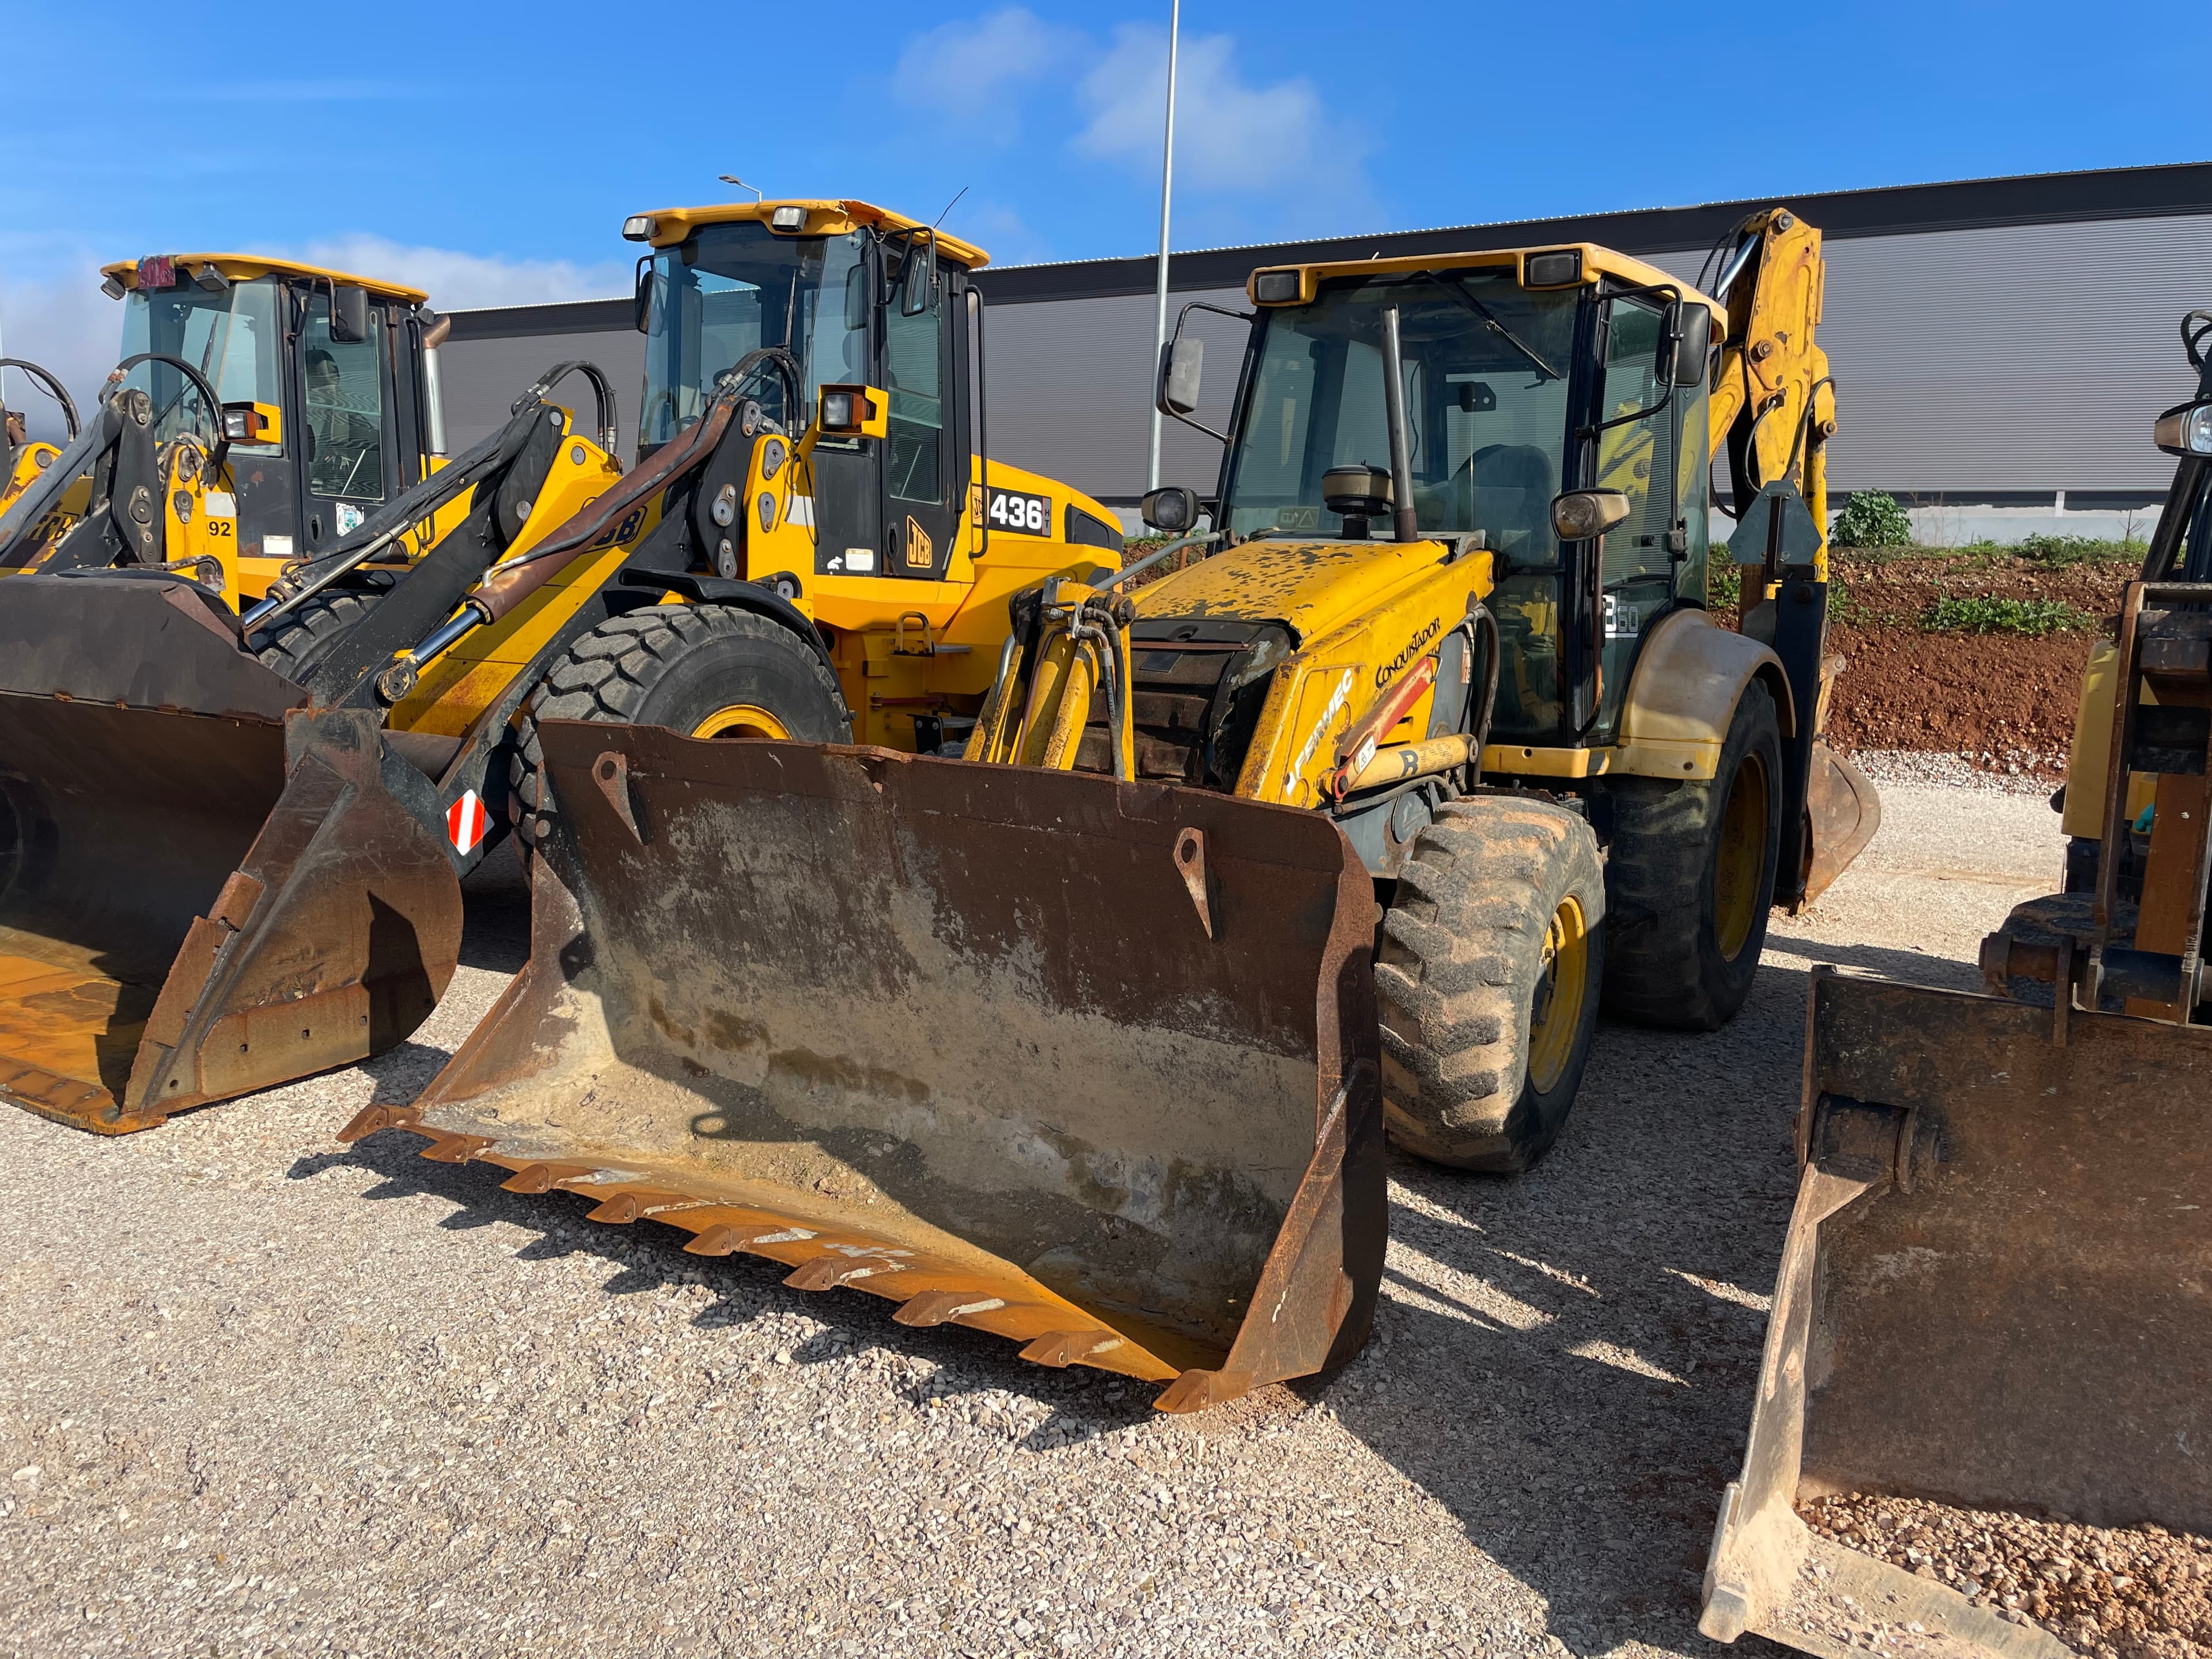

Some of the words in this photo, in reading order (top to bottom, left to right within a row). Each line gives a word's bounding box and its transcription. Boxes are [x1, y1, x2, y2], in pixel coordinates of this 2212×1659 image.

[209, 521, 231, 536] 92
[990, 494, 1042, 529] 436
[909, 523, 930, 565] JCB
